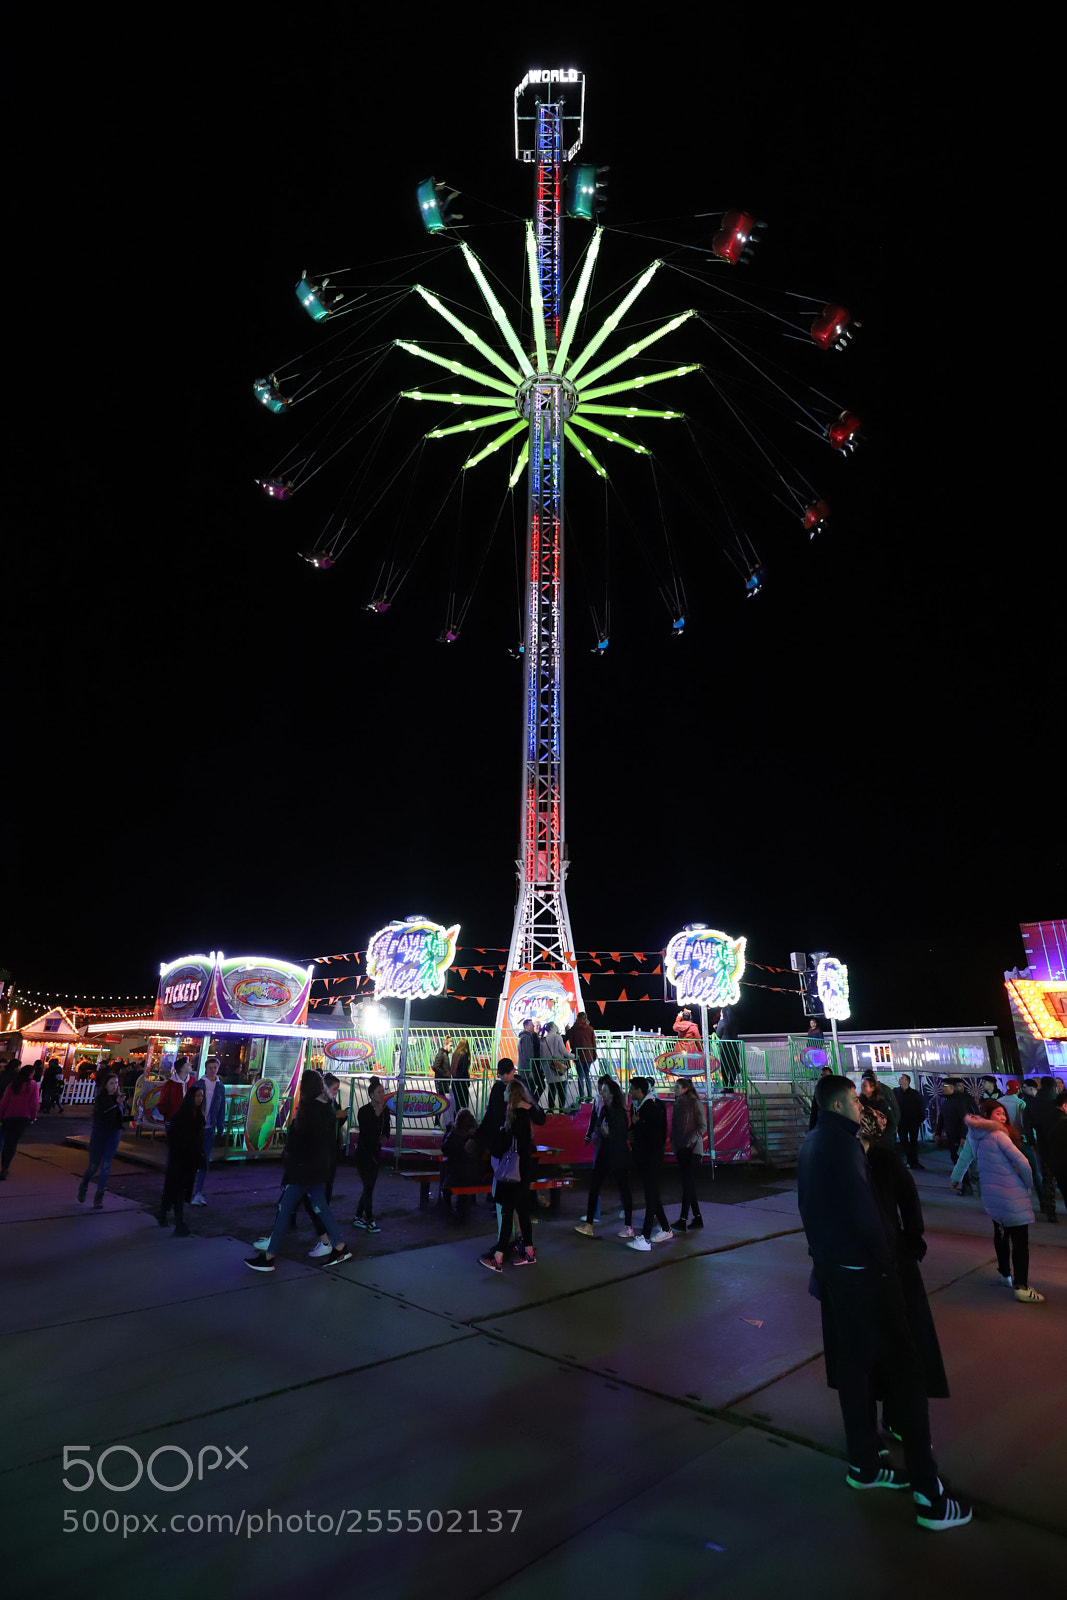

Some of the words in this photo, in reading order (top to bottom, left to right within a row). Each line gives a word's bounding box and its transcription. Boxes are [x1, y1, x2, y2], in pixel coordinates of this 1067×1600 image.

[528, 69, 578, 83] WORLD
[403, 946, 429, 964] the
[698, 955, 722, 972] the
[164, 980, 202, 1005] TICKETS
[331, 1049, 367, 1057] ENTRANCE
[687, 1058, 716, 1070] HIGH
[393, 1094, 437, 1104] ENGANG
